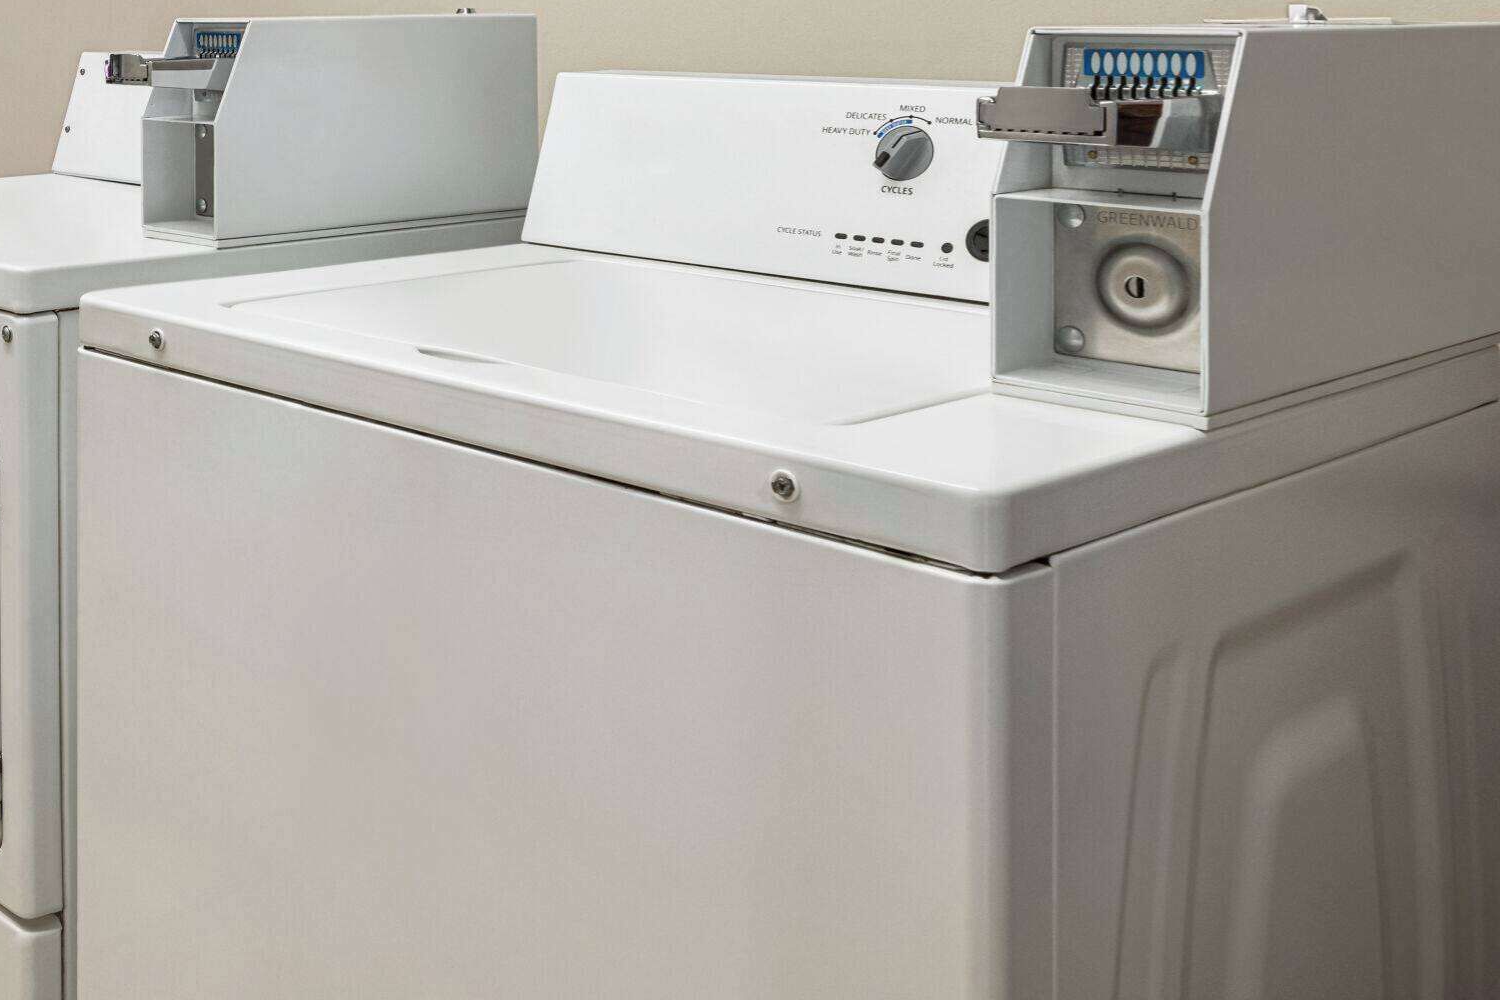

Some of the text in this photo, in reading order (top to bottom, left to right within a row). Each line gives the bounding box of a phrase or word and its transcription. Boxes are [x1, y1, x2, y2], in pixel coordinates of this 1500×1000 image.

[899, 104, 926, 113] MIXED
[845, 112, 888, 121] DELICATES
[935, 117, 974, 126] NORMAL
[821, 126, 872, 136] HEAVY DUTY
[881, 185, 914, 195] CYCLES
[1096, 210, 1199, 231] GREENWALD
[776, 226, 822, 237] CYCLE STATUS
[933, 261, 955, 269] Locked
